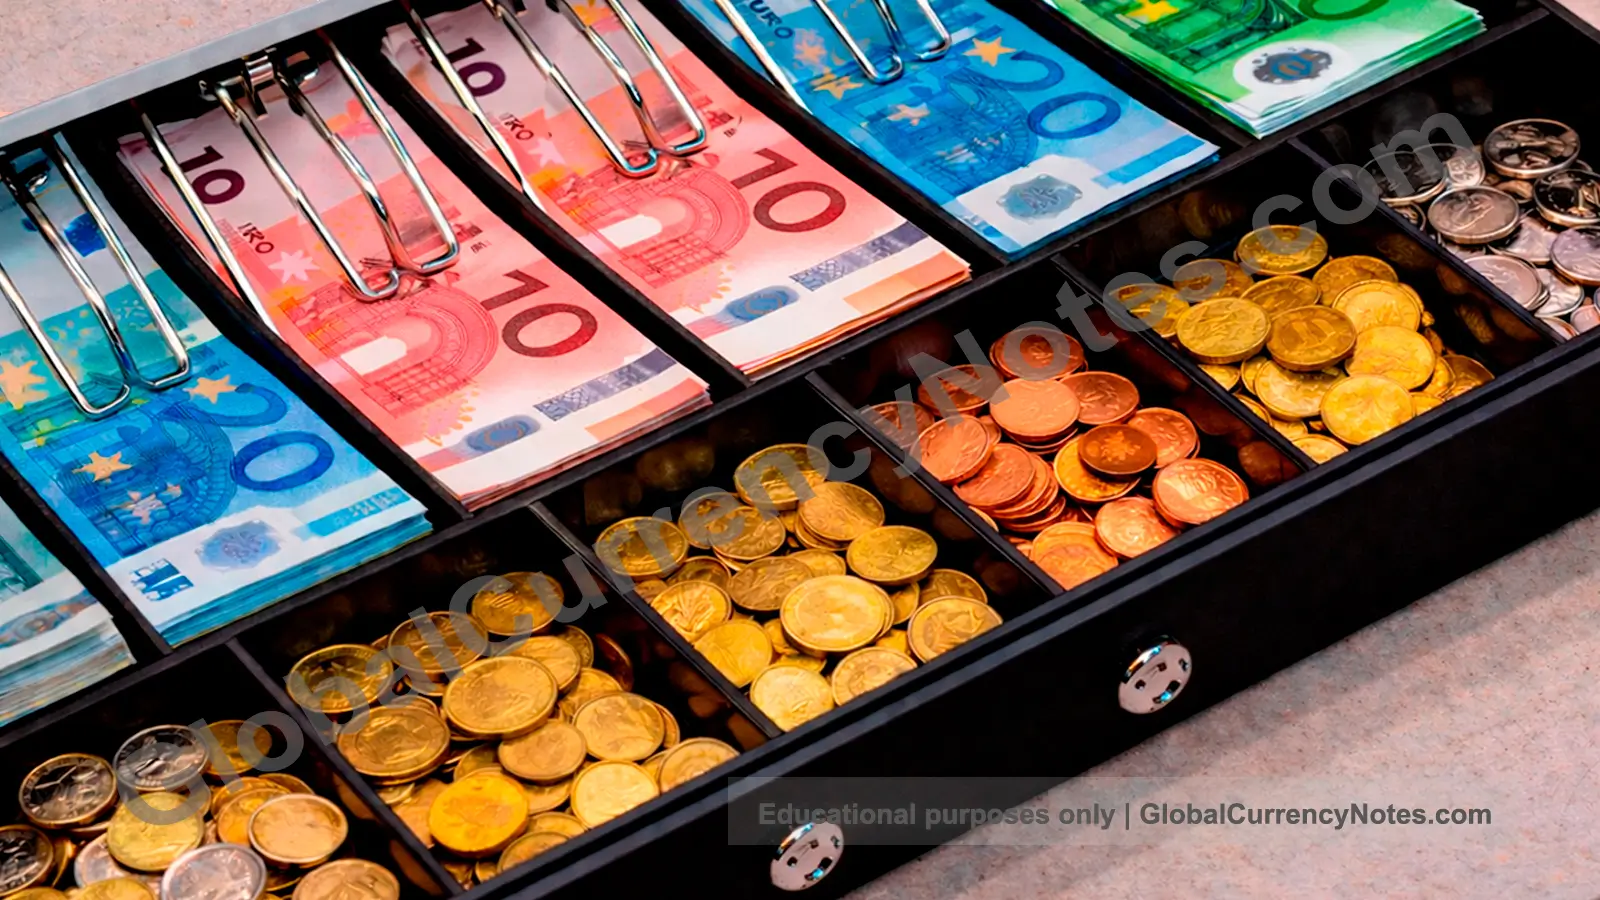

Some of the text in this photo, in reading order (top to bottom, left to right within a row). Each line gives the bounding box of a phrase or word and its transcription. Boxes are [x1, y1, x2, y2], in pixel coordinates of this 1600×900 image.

[436, 36, 506, 97] 10
[168, 145, 245, 205] 10
[730, 147, 847, 233] 10
[480, 269, 598, 358] 10
